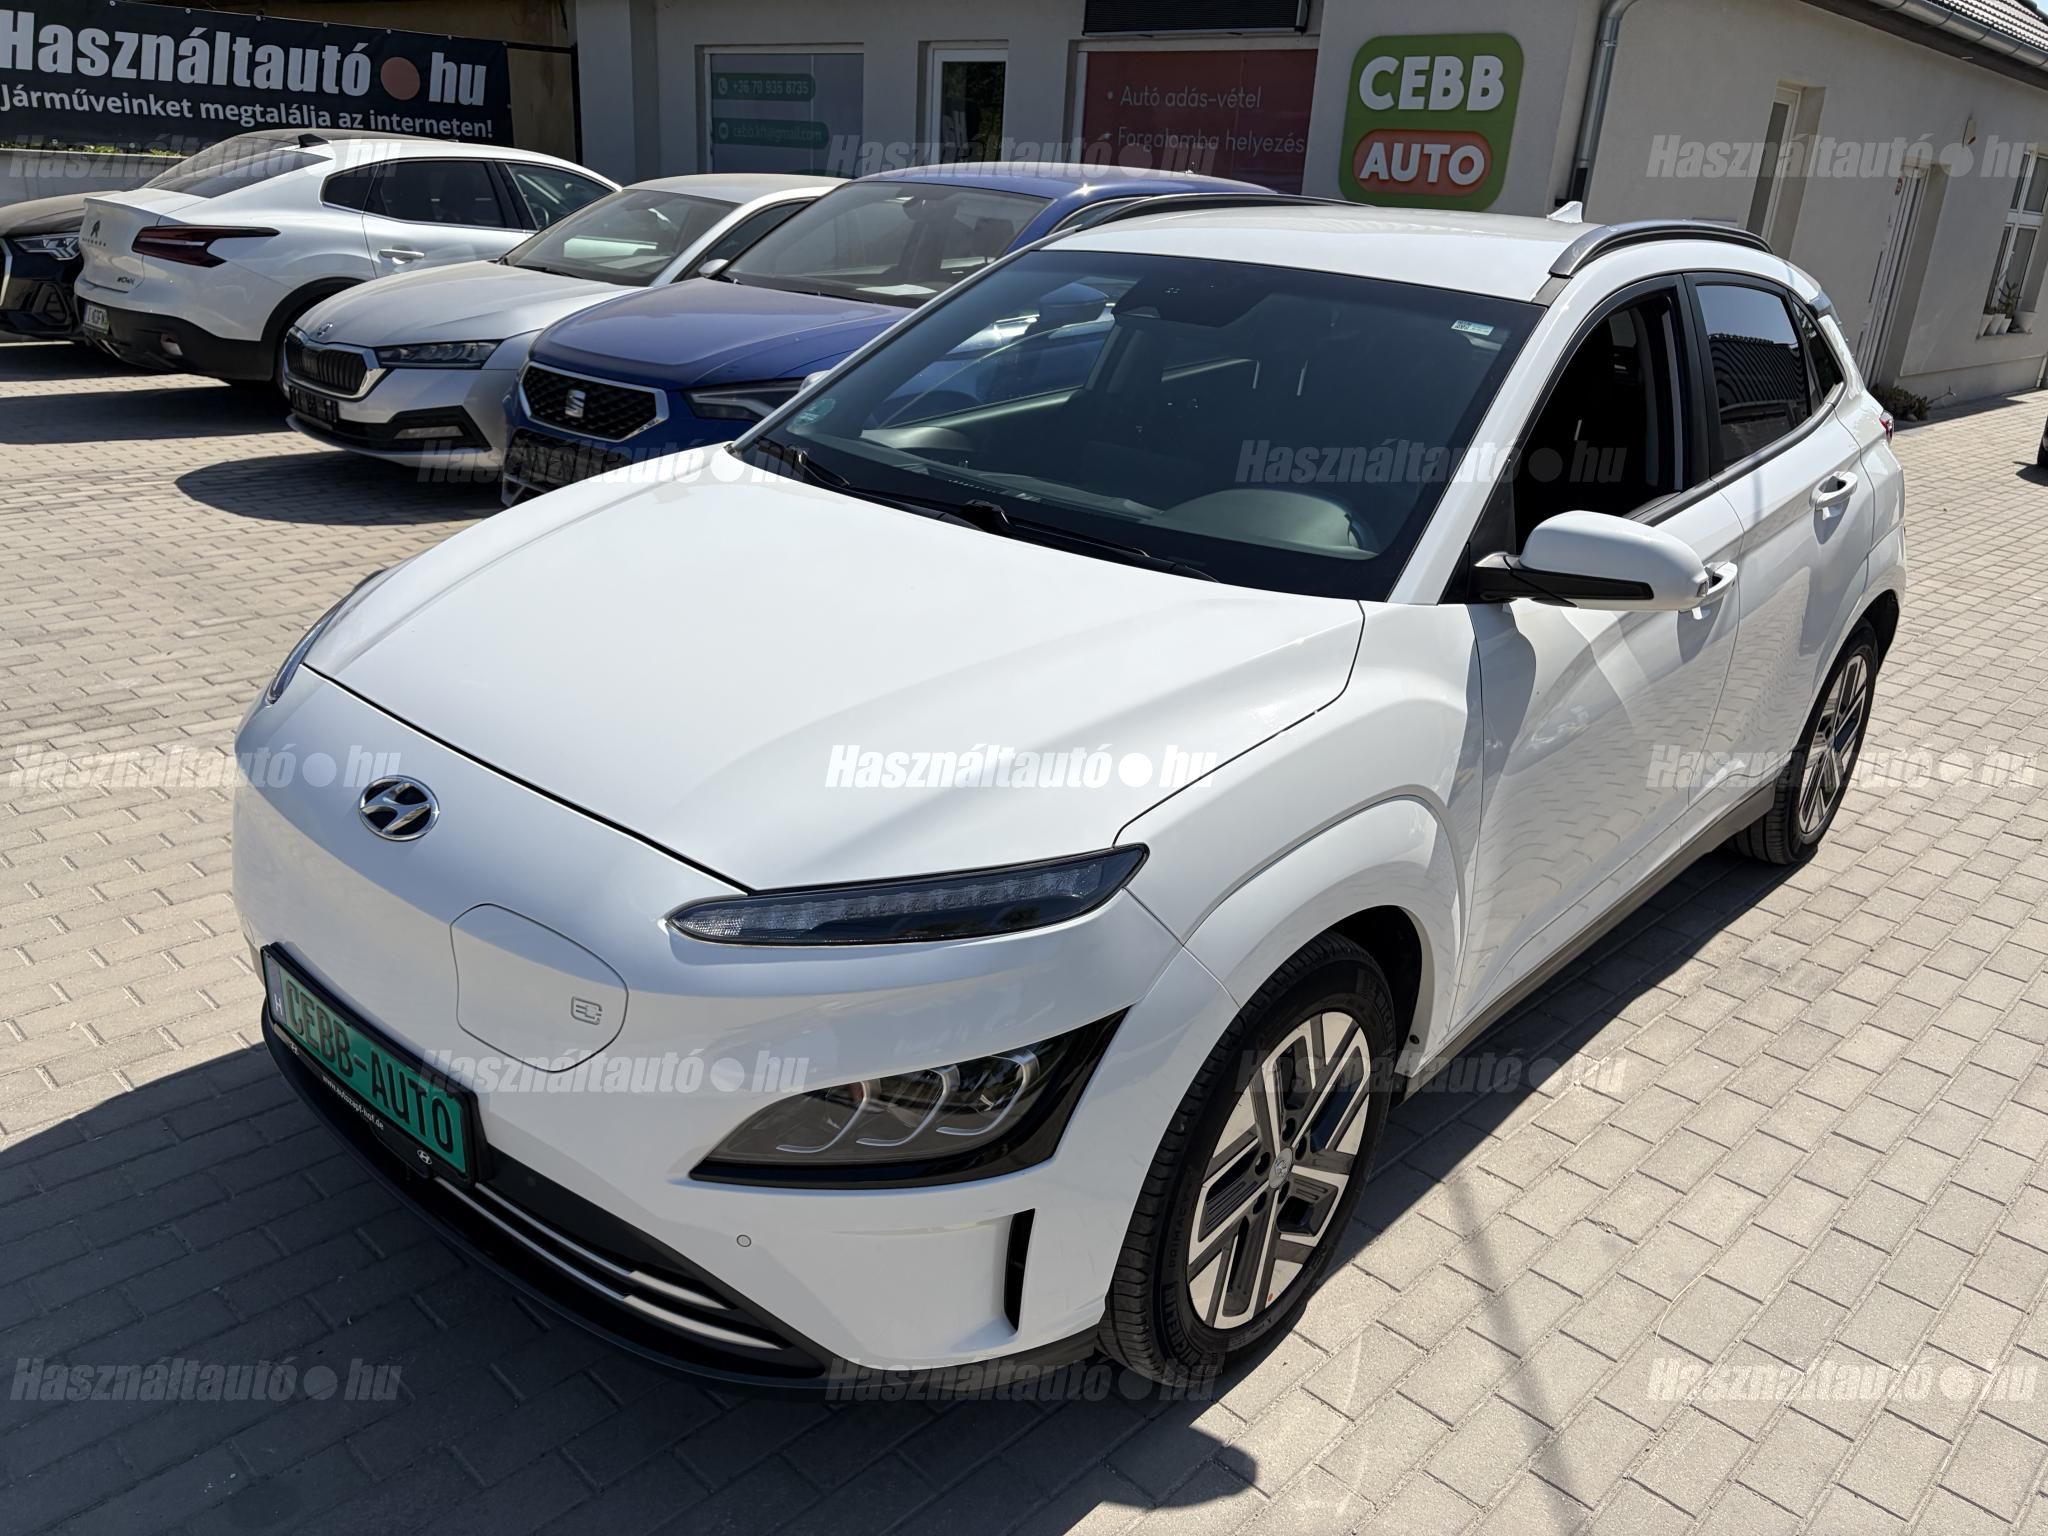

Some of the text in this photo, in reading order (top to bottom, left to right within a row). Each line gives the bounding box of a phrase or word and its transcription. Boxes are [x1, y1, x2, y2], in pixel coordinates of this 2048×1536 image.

[0, 9, 371, 97] Használtautó
[0, 83, 493, 138] Járműveinket megtalálja az interneten!
[1120, 86, 1262, 109] Autó adás-vétel
[1359, 55, 1504, 112] CEBB
[1118, 126, 1305, 157] Forgalomba helyezés
[1359, 142, 1485, 186] AUTO
[286, 979, 454, 1154] CEBB-AUTO
